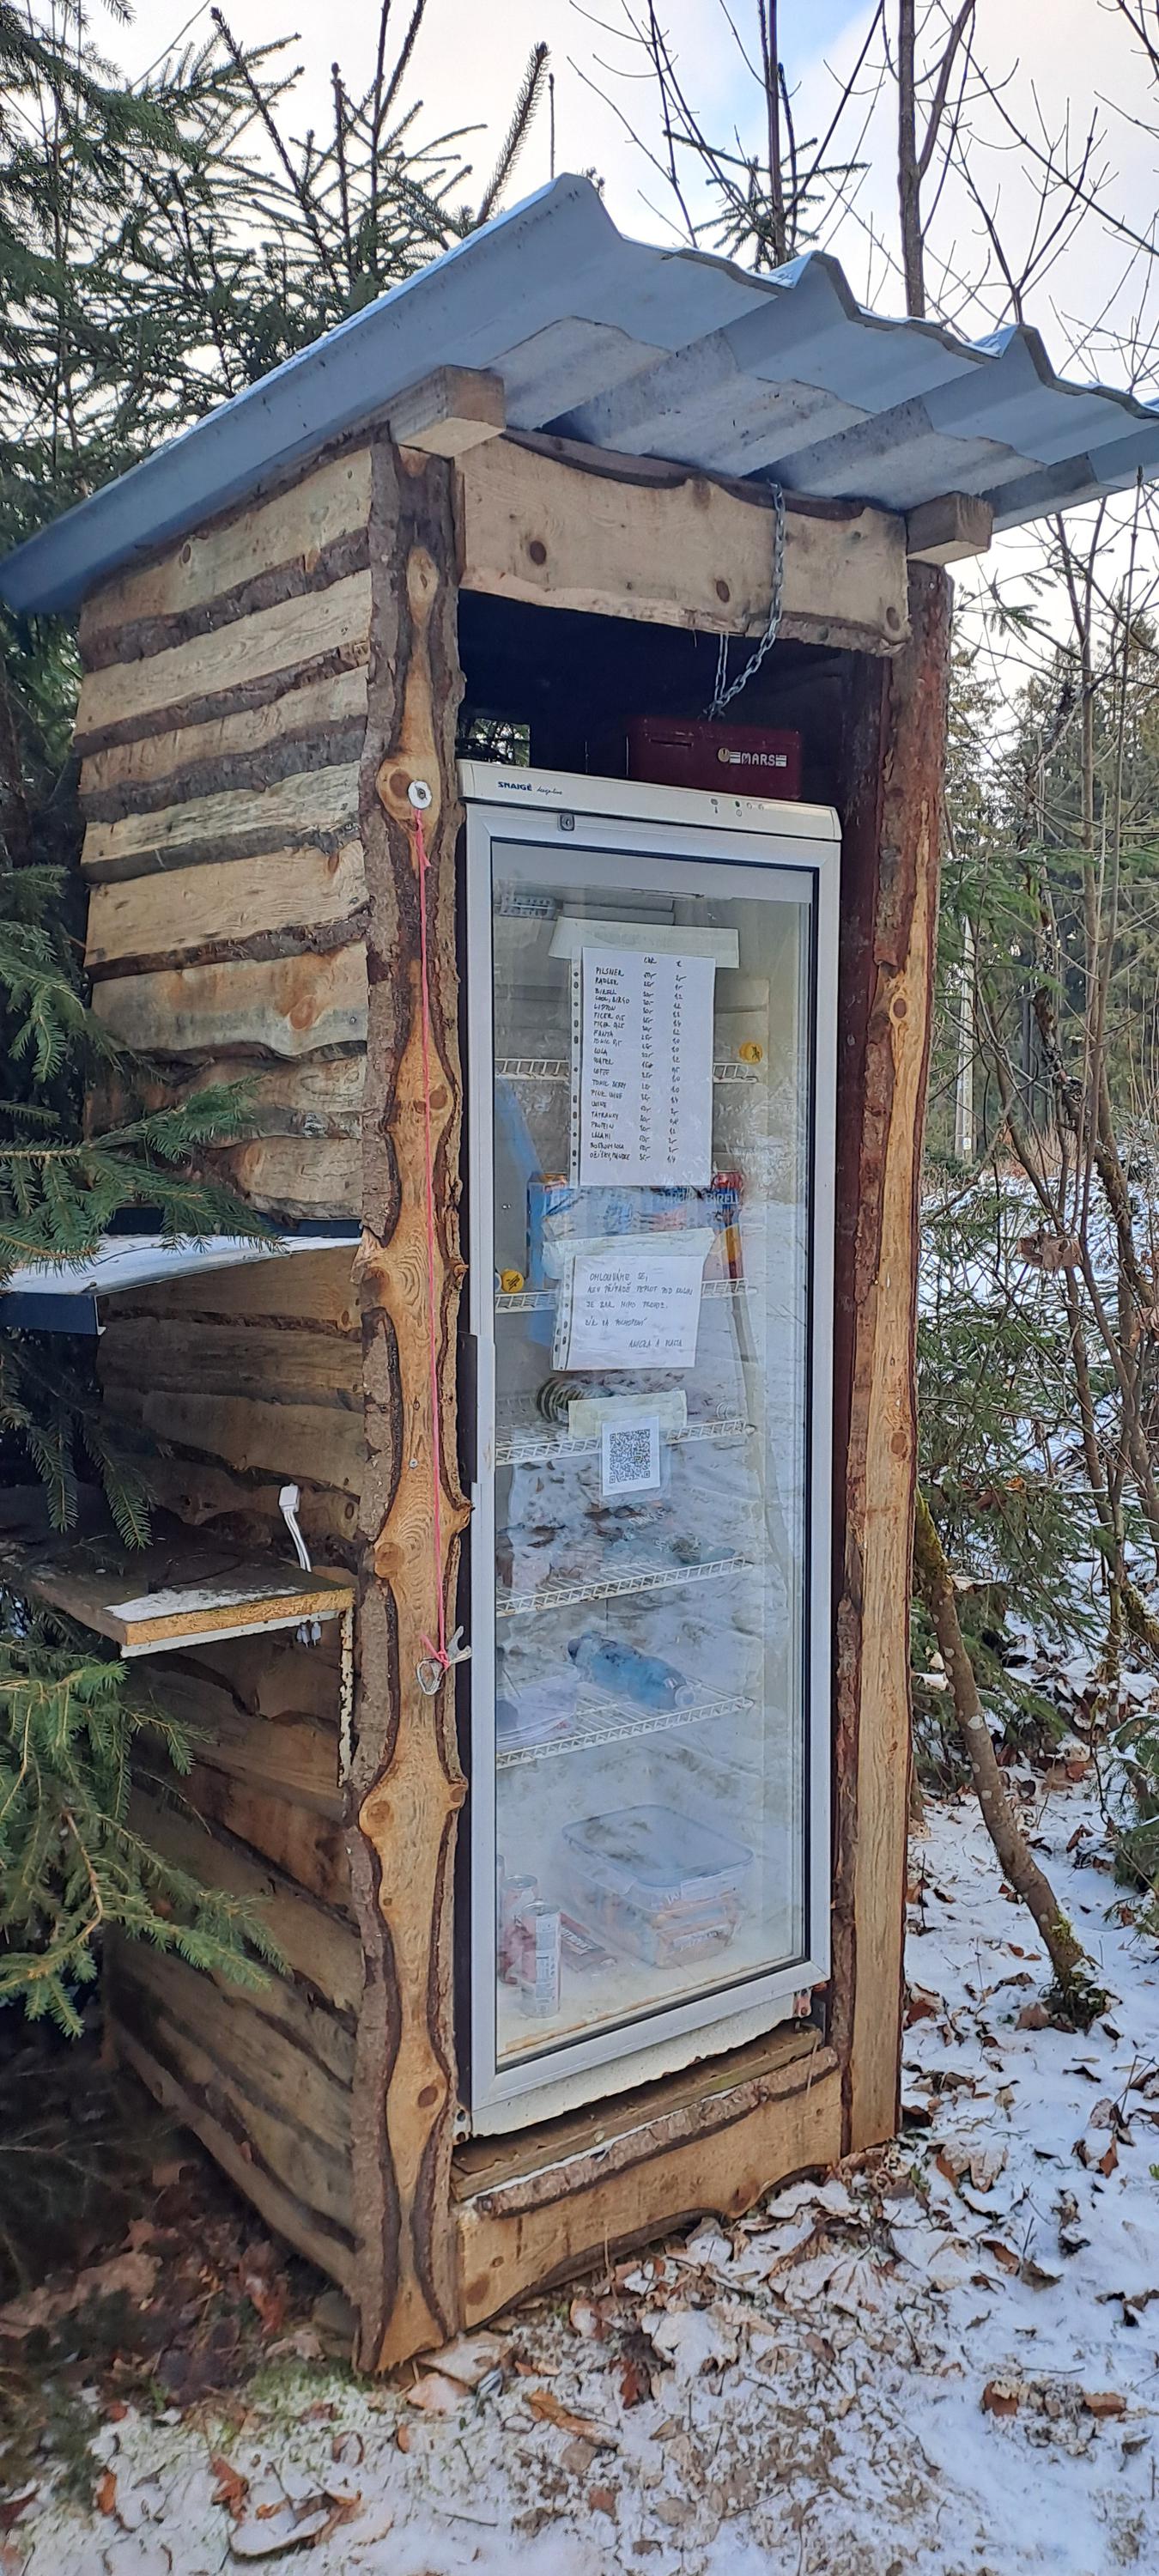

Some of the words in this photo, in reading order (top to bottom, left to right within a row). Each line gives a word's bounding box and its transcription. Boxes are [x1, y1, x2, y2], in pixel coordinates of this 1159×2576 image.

[741, 752, 775, 766] MARS
[596, 967, 625, 977] PILSNER
[595, 977, 618, 986] RADLER
[594, 1003, 616, 1012] LIPTON
[591, 1111, 619, 1120] TATRANKY
[591, 1121, 614, 1130] PROTEIN
